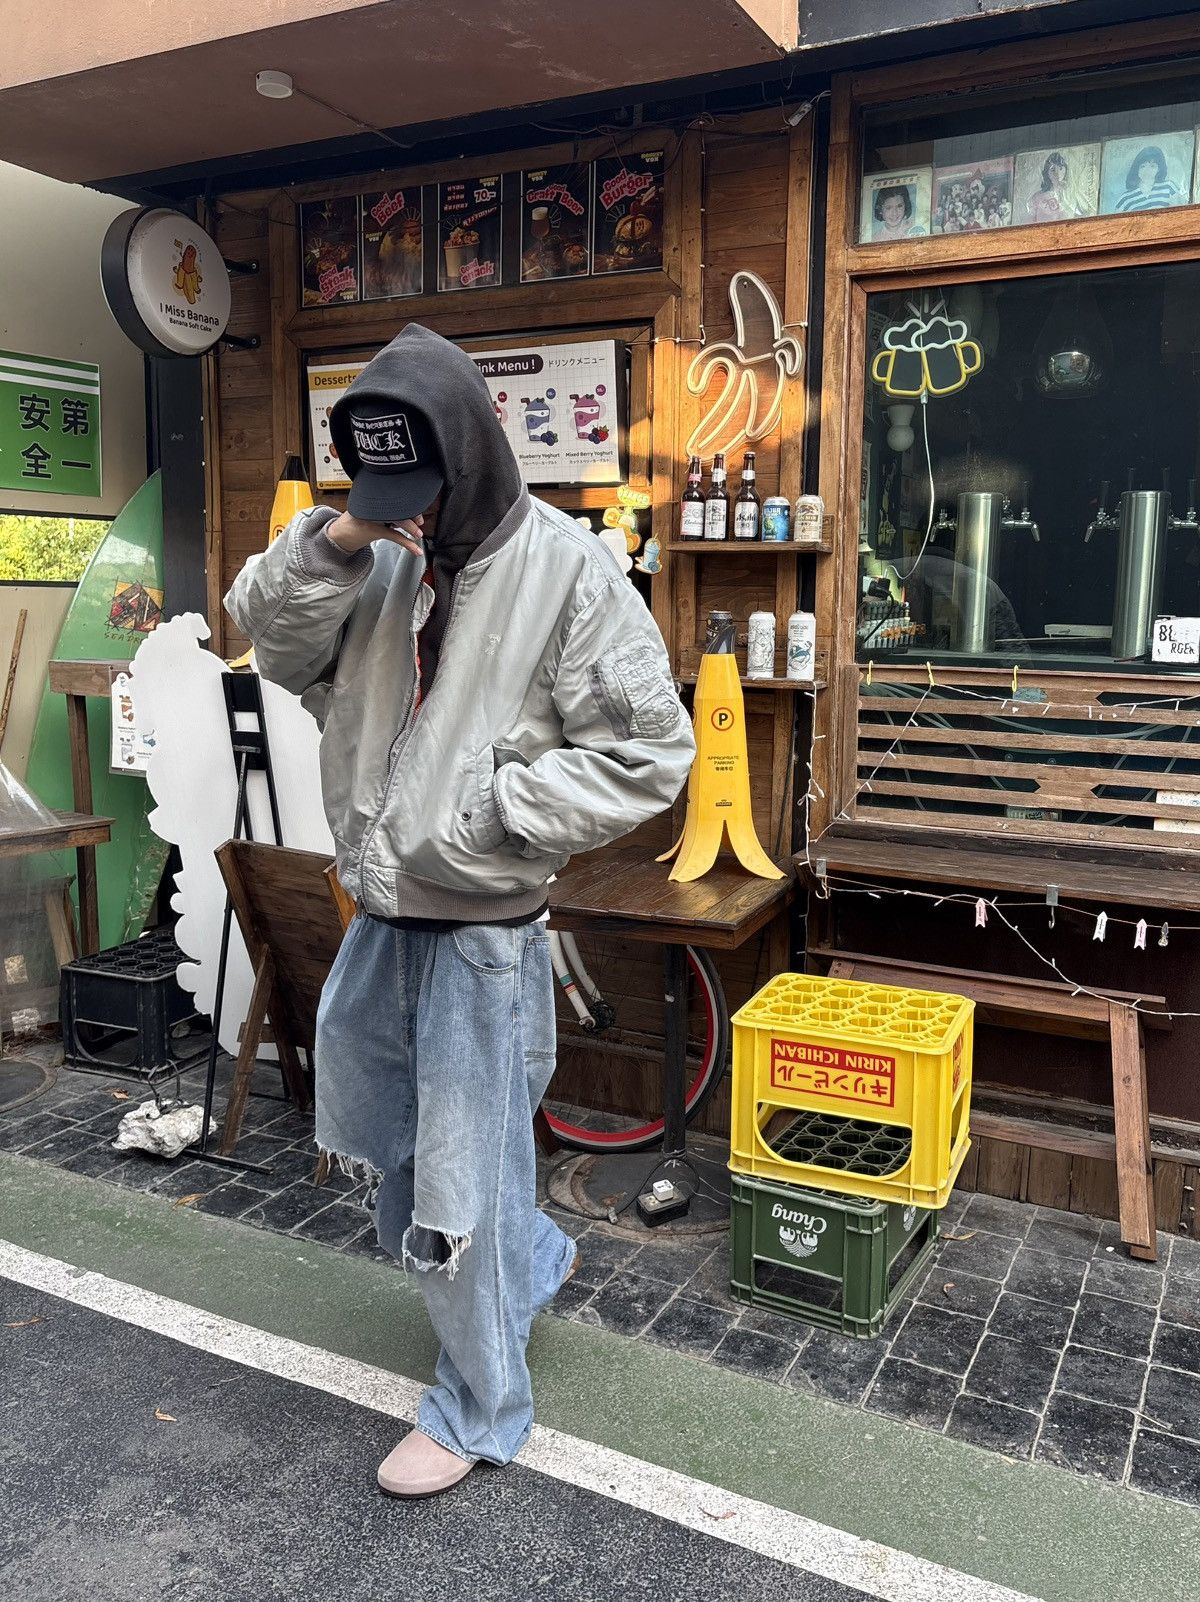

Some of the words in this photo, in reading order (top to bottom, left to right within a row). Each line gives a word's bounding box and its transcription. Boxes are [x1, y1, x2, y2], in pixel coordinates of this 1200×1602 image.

[603, 170, 627, 190] Good
[602, 176, 650, 207] Burger
[560, 193, 584, 215] Beer
[160, 303, 163, 313] I
[165, 304, 186, 318] Miss
[187, 309, 220, 327] Banana
[169, 318, 188, 328] Banana
[188, 322, 200, 330] Soft
[200, 325, 212, 333] Cake
[478, 363, 495, 373] ink
[497, 361, 529, 371] Menu
[548, 357, 606, 368] ドリンクメニュー
[718, 712, 729, 726] P
[774, 1043, 839, 1065] ICHIBAN
[845, 1055, 892, 1074] KIRIN
[776, 1064, 889, 1098] キリンビール
[771, 1203, 828, 1234] Chang
